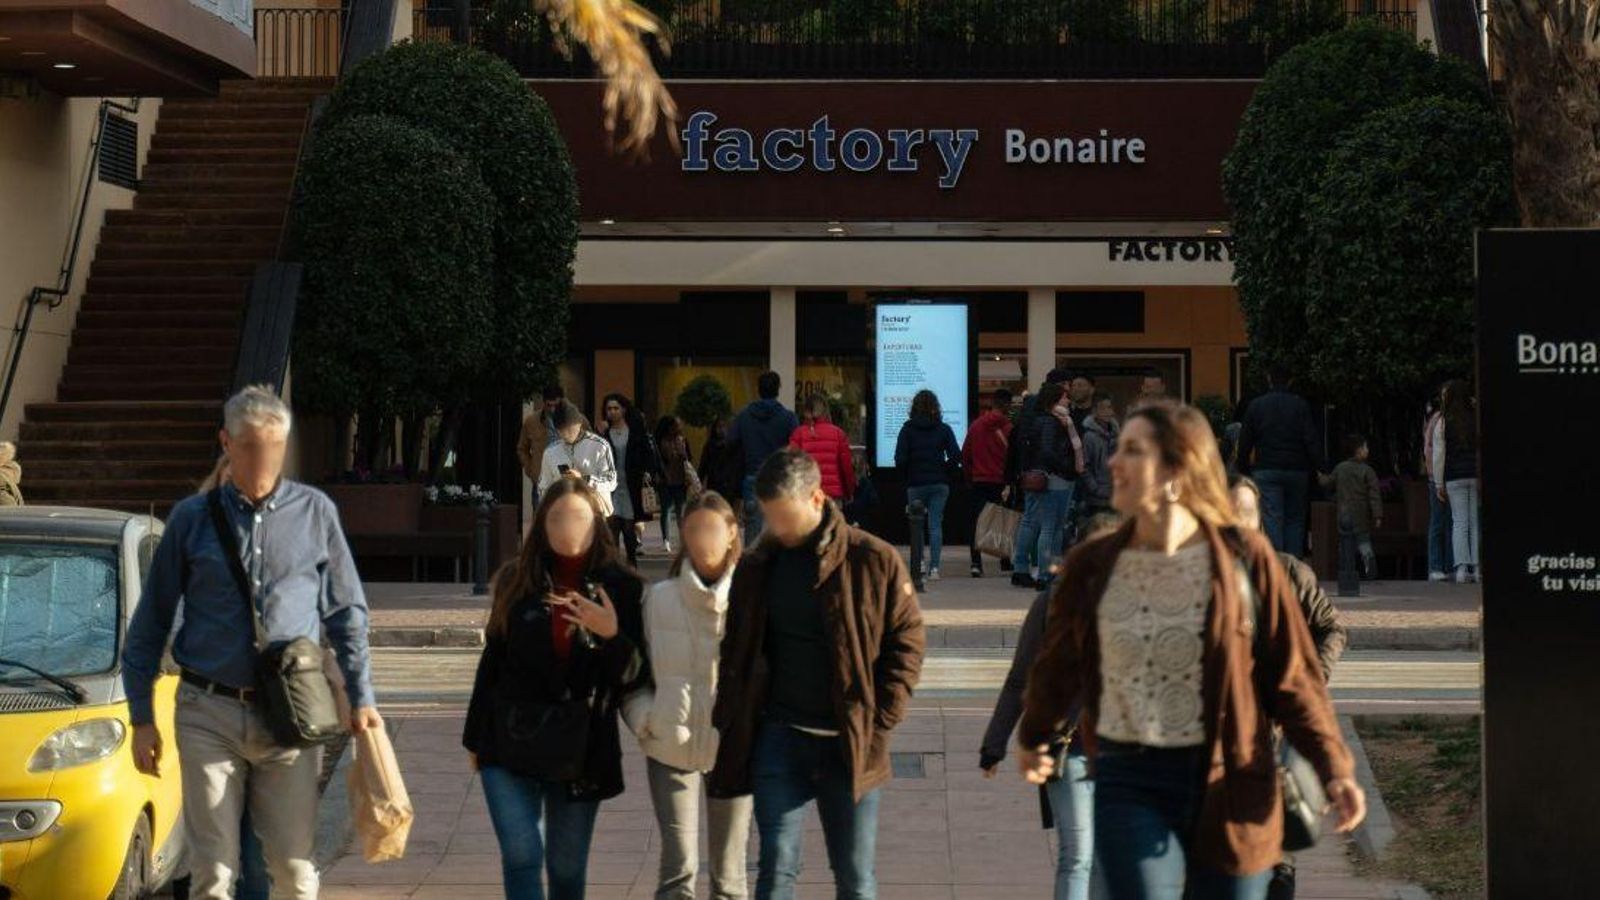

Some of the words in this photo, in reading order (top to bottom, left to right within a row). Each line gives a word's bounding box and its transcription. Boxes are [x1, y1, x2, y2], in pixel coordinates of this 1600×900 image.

[681, 111, 978, 188] factory
[1005, 129, 1146, 163] Bonaire
[1527, 552, 1596, 574] gracias
[1542, 574, 1564, 591] tu
